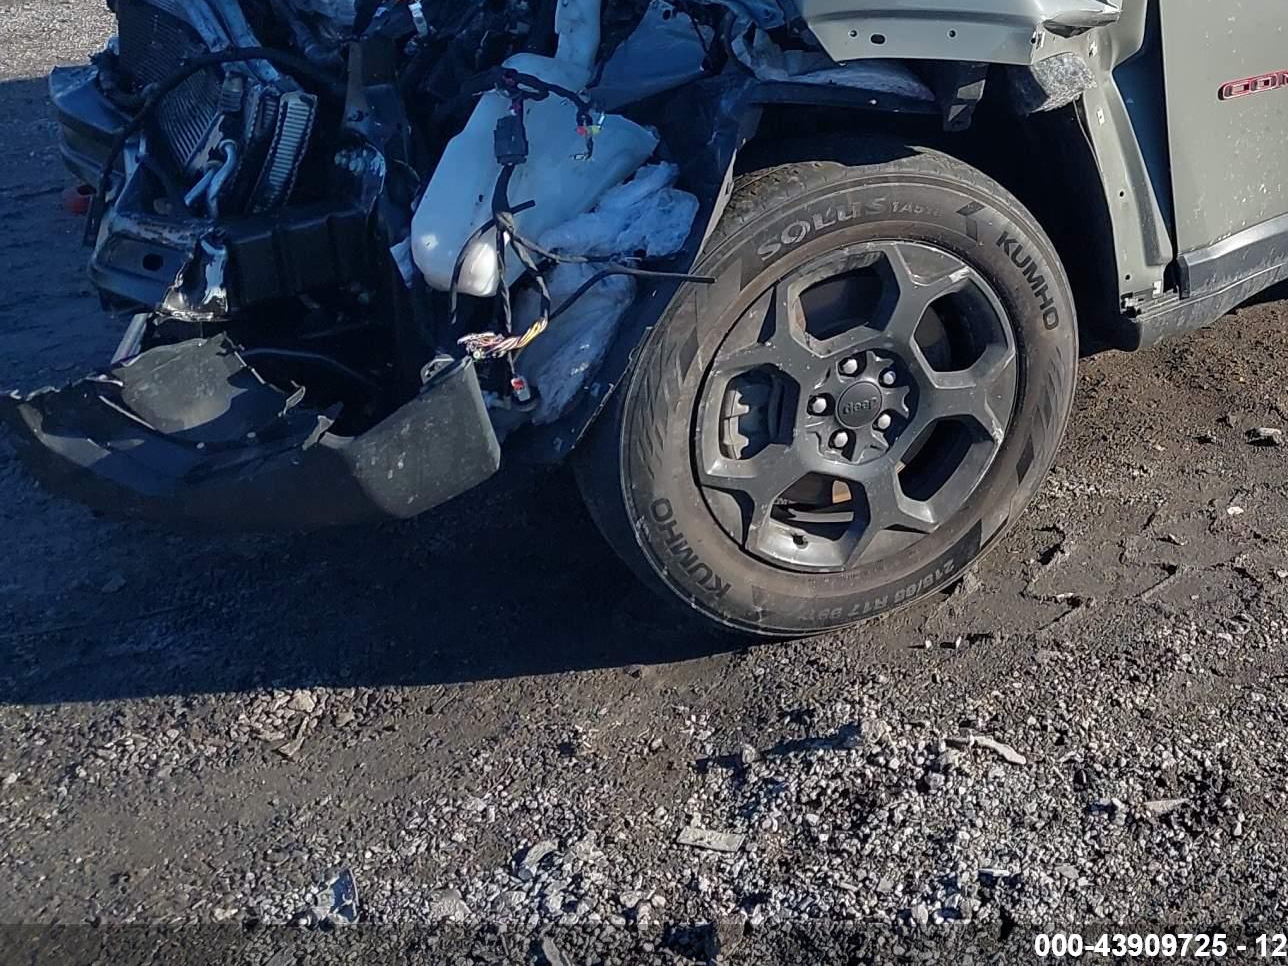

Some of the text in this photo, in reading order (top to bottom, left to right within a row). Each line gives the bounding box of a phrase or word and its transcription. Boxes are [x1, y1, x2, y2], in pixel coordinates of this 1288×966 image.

[757, 196, 887, 262] SOLUS
[995, 230, 1060, 331] KUMHO
[649, 496, 732, 597] KUMHO
